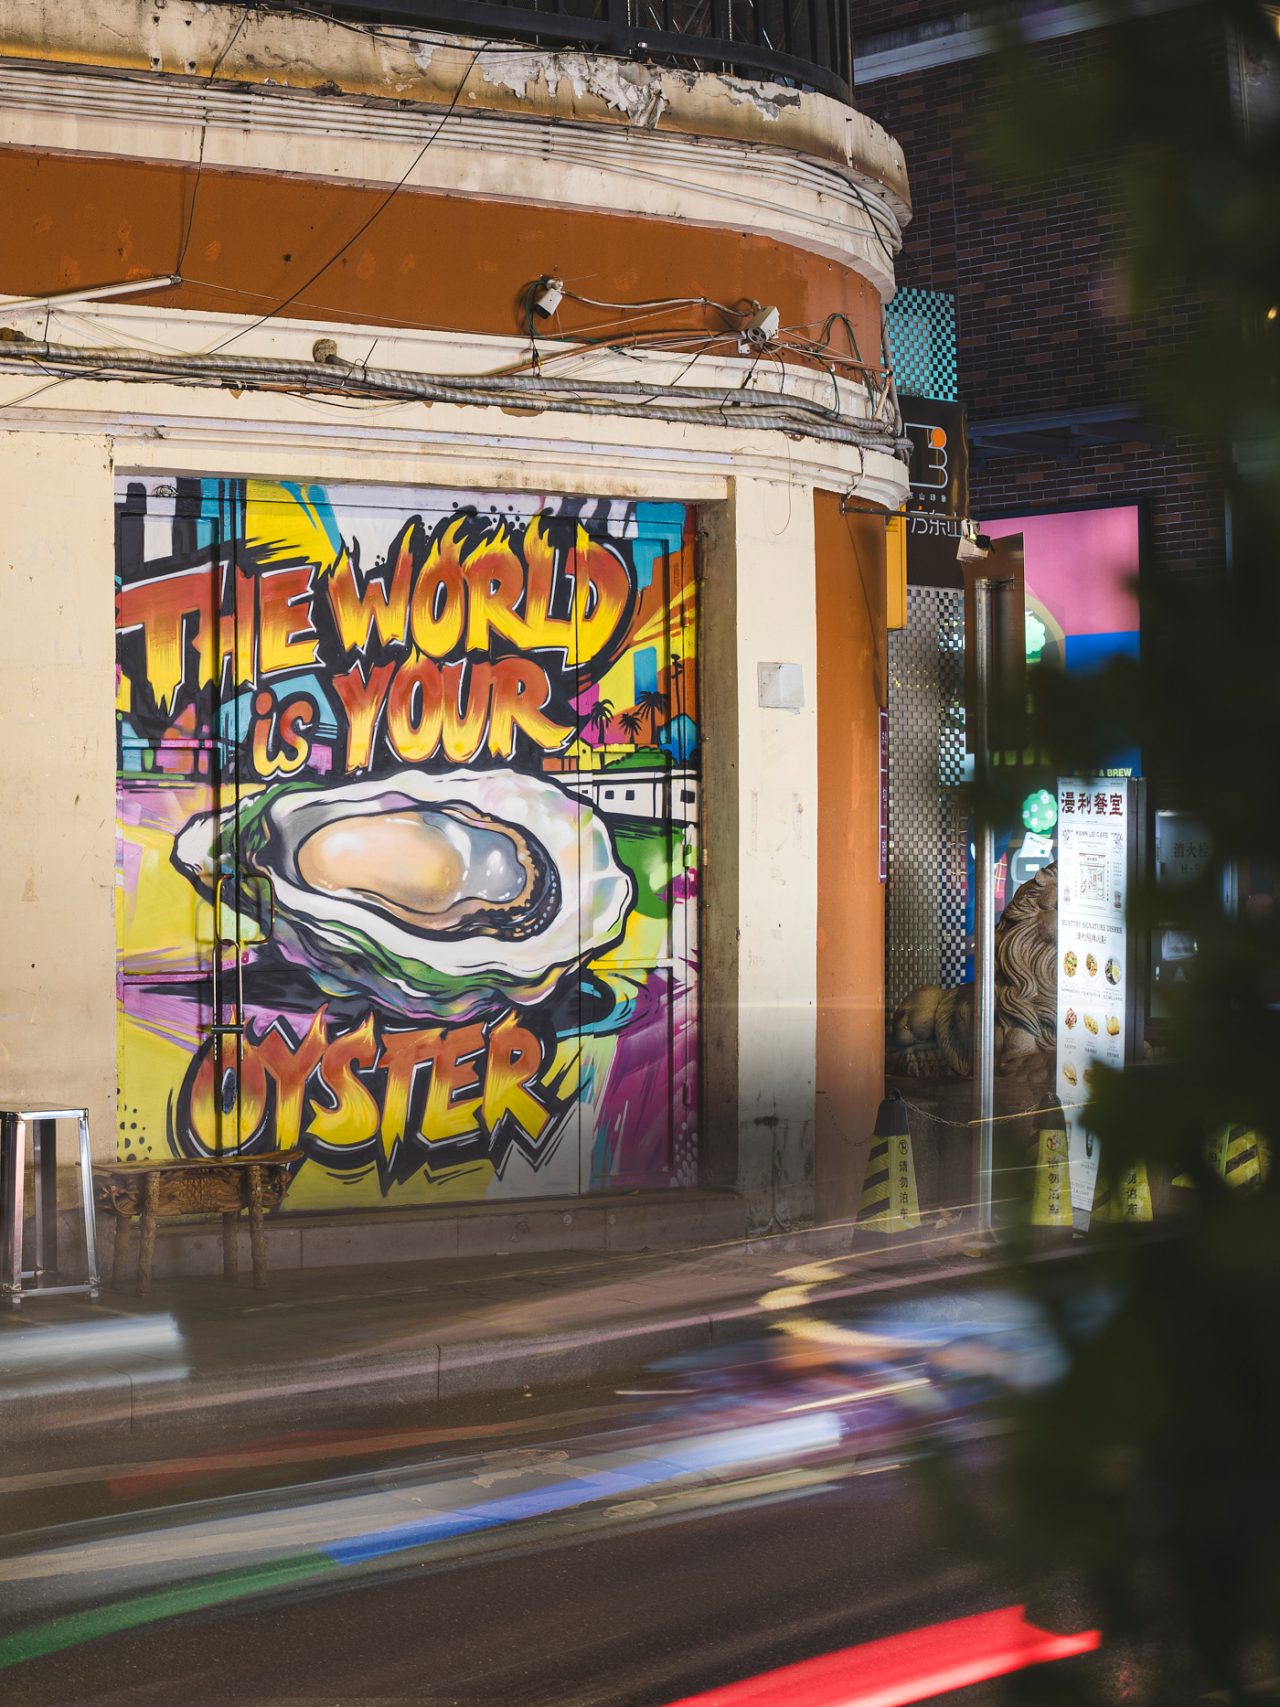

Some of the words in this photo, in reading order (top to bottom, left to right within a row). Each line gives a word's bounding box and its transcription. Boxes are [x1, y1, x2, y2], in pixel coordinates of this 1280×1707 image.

[116, 562, 322, 716] THE
[327, 514, 630, 666] WORLD
[254, 692, 314, 777] is
[332, 655, 578, 771] YOUR
[1106, 767, 1132, 777] BREW
[1061, 791, 1123, 817] 漫利餐室
[190, 1005, 554, 1162] OYSTER
[898, 1160, 909, 1220] 请勿泊车
[1126, 1172, 1138, 1216] 勿泊车
